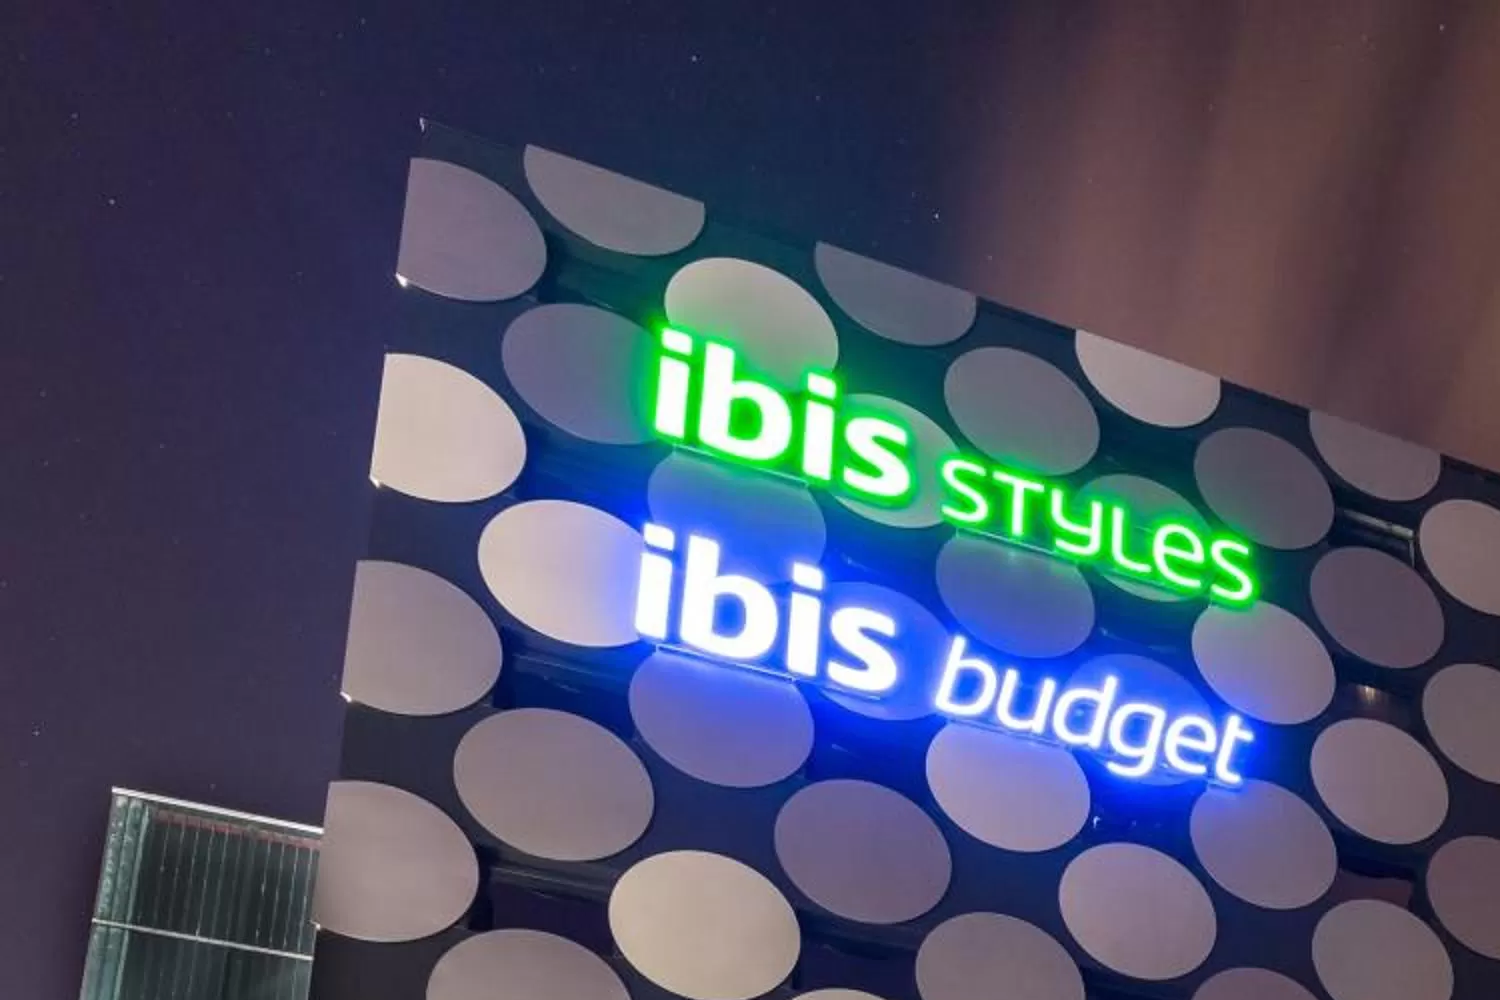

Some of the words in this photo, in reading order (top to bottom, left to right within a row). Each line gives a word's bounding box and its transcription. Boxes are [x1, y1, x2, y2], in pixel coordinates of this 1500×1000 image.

[654, 329, 910, 496] ibis
[633, 522, 898, 693] ibis
[933, 636, 1254, 784] budget
